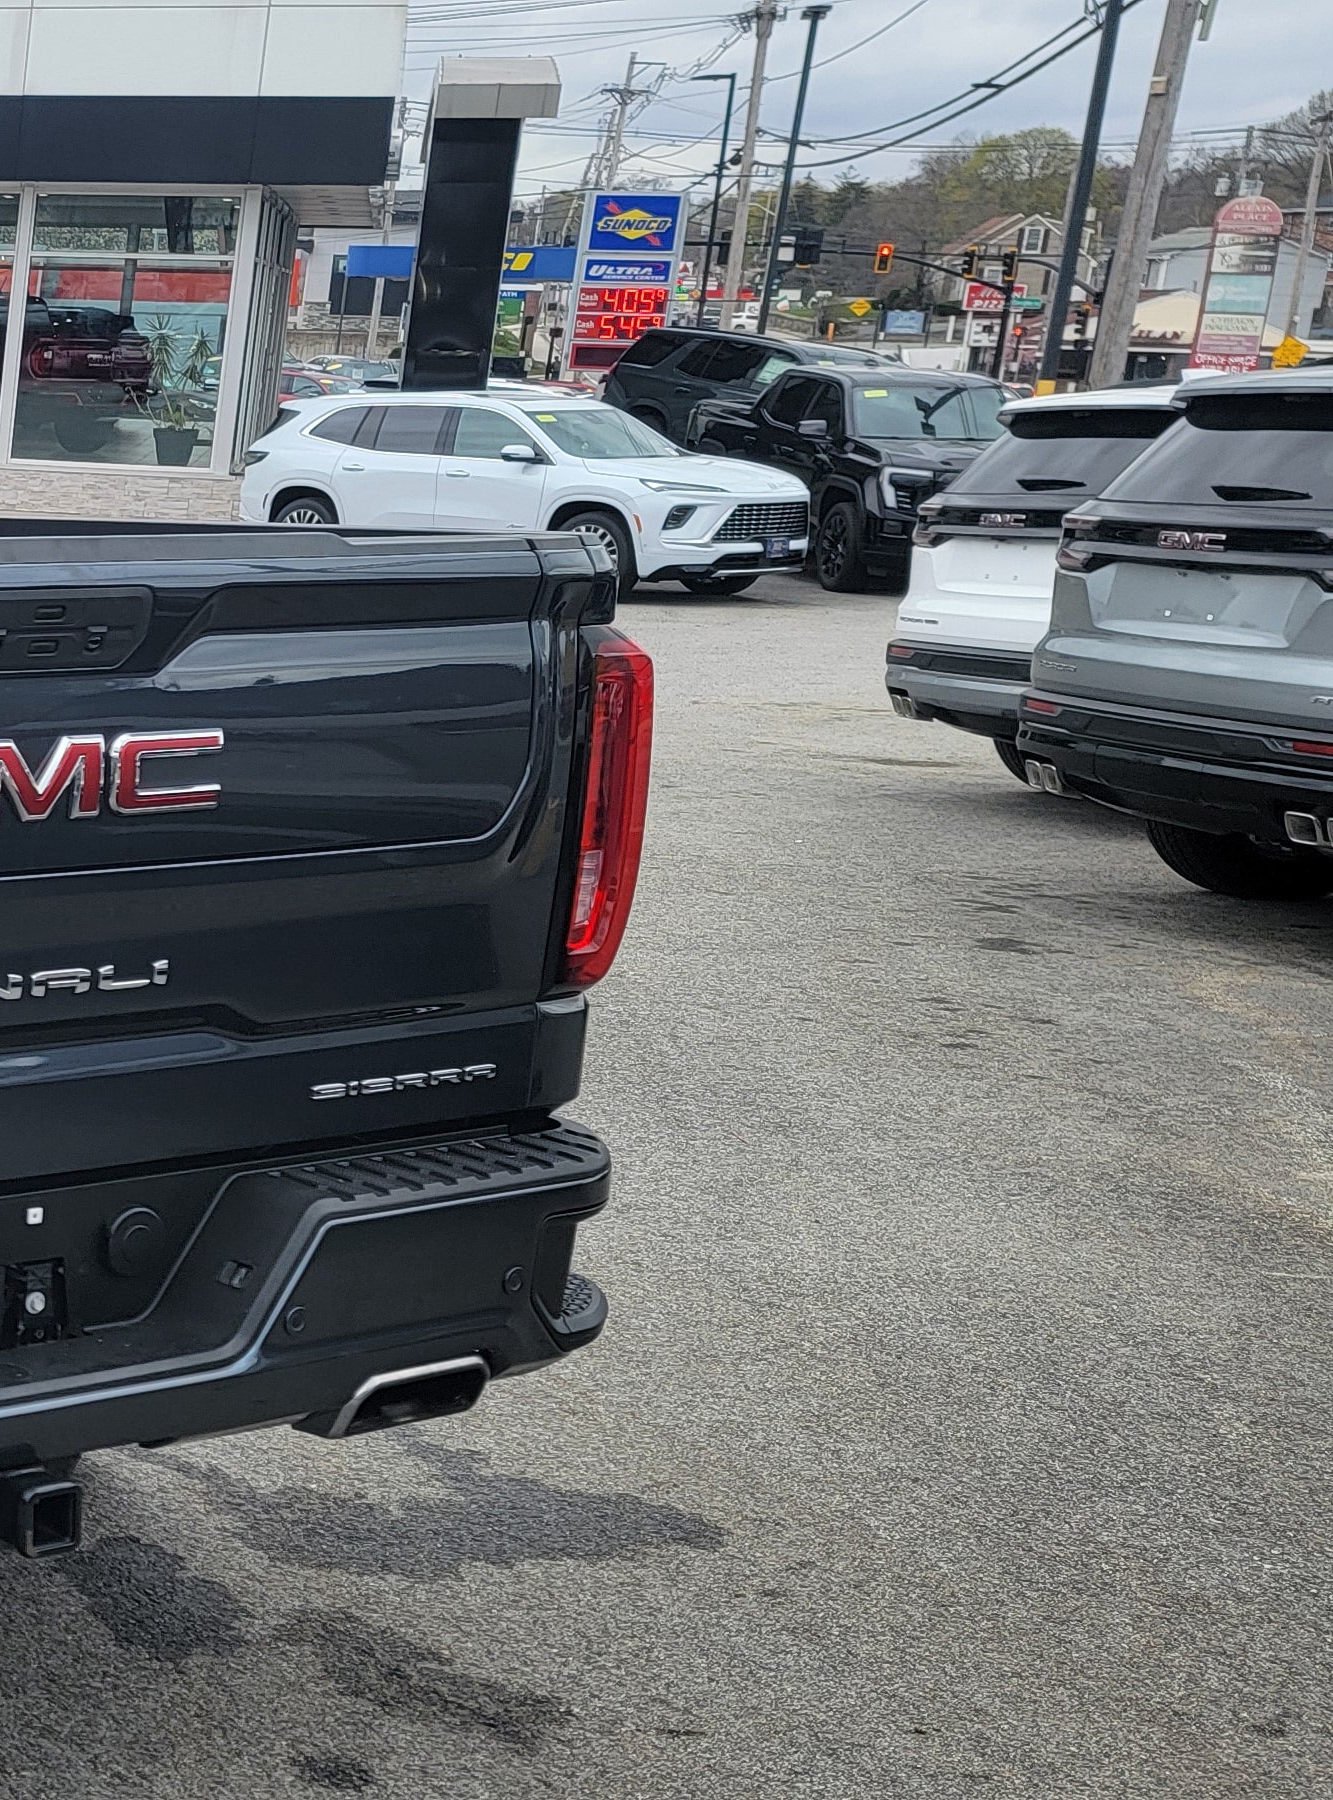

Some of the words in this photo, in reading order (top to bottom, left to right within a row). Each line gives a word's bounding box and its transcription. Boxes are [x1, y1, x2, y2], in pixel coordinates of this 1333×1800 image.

[600, 218, 671, 231] SUNOCO
[588, 265, 653, 276] ULTRA
[580, 293, 599, 301] Cash
[576, 320, 595, 328] Cash
[979, 514, 1027, 528] GMC
[1157, 530, 1227, 551] GMC
[309, 1063, 498, 1101] SIERRA
